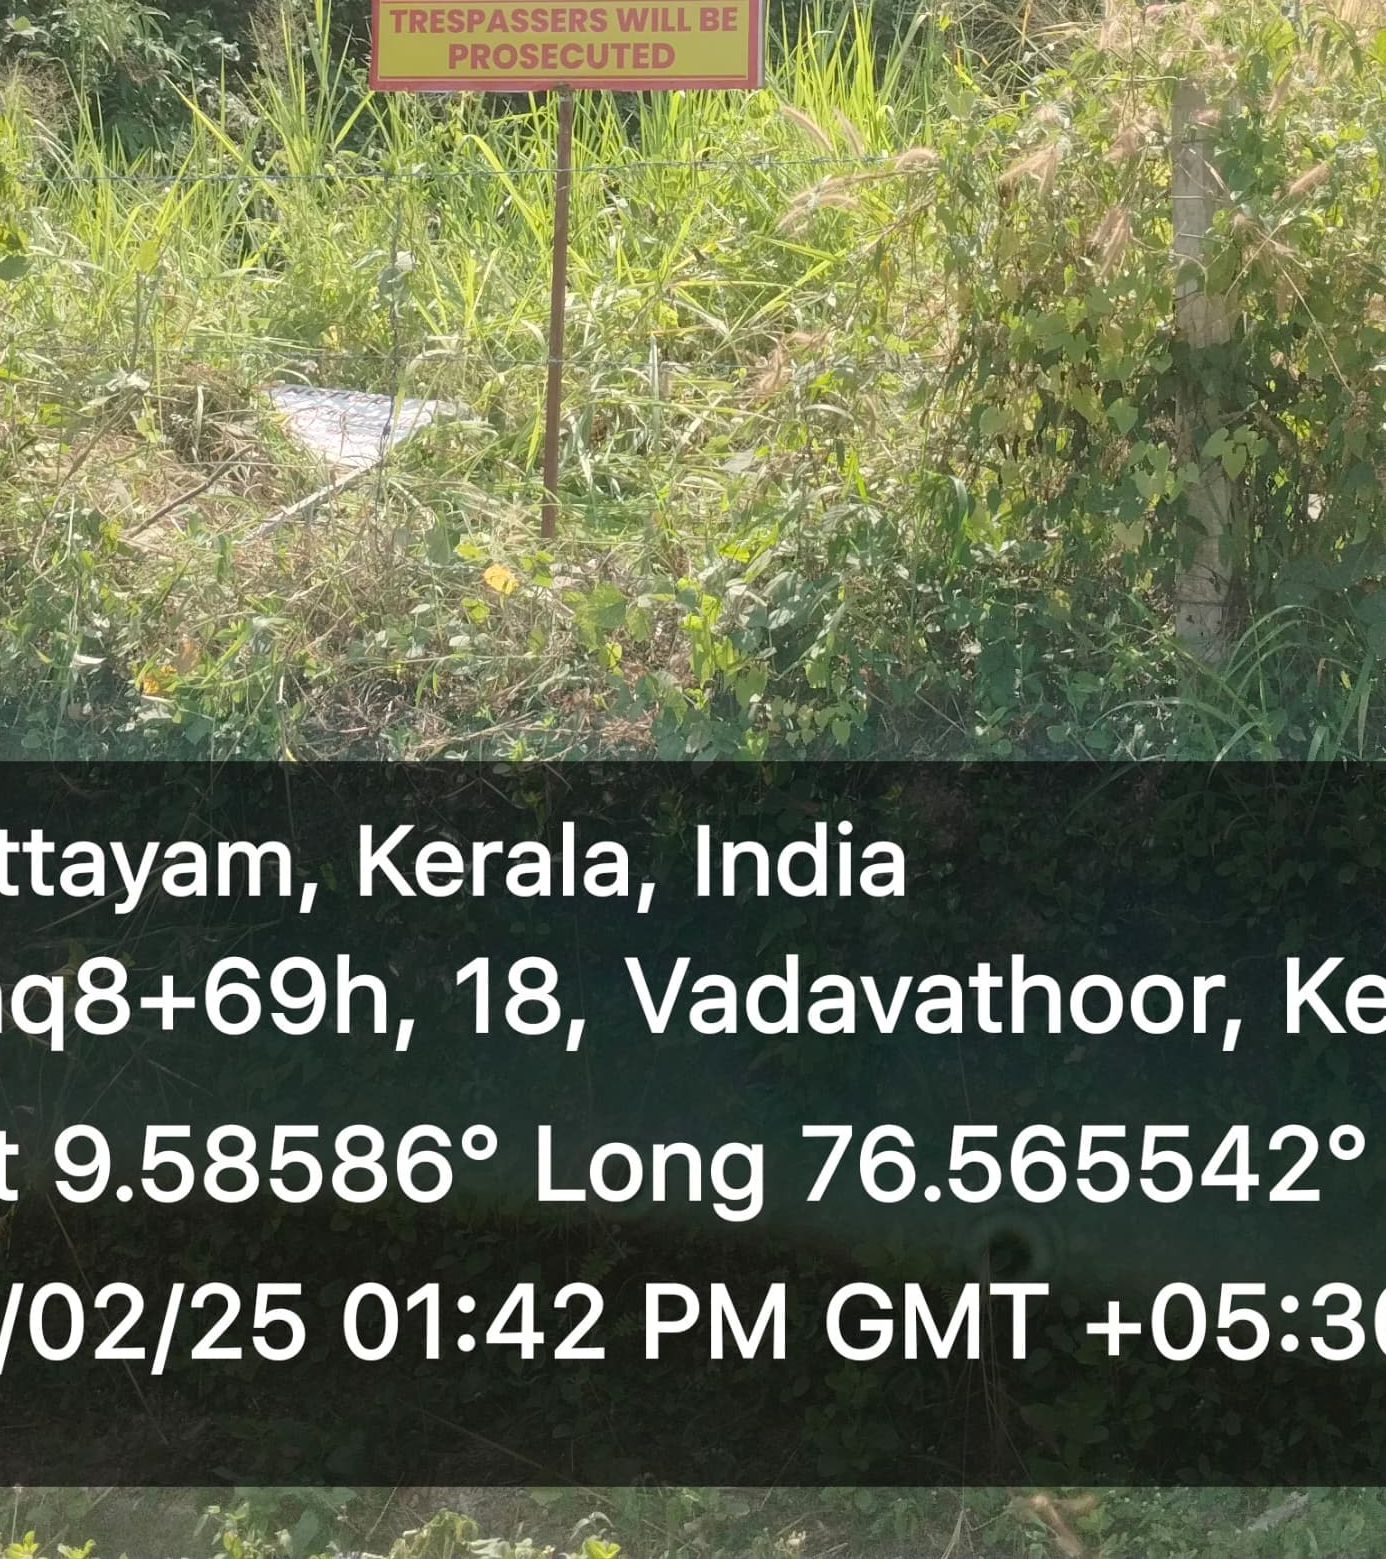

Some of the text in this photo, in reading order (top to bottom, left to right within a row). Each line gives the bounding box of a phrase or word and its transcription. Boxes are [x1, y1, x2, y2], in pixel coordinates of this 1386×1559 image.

[389, 7, 738, 33] TRESPASSERS WILL BE
[448, 43, 675, 70] PROSECUTED
